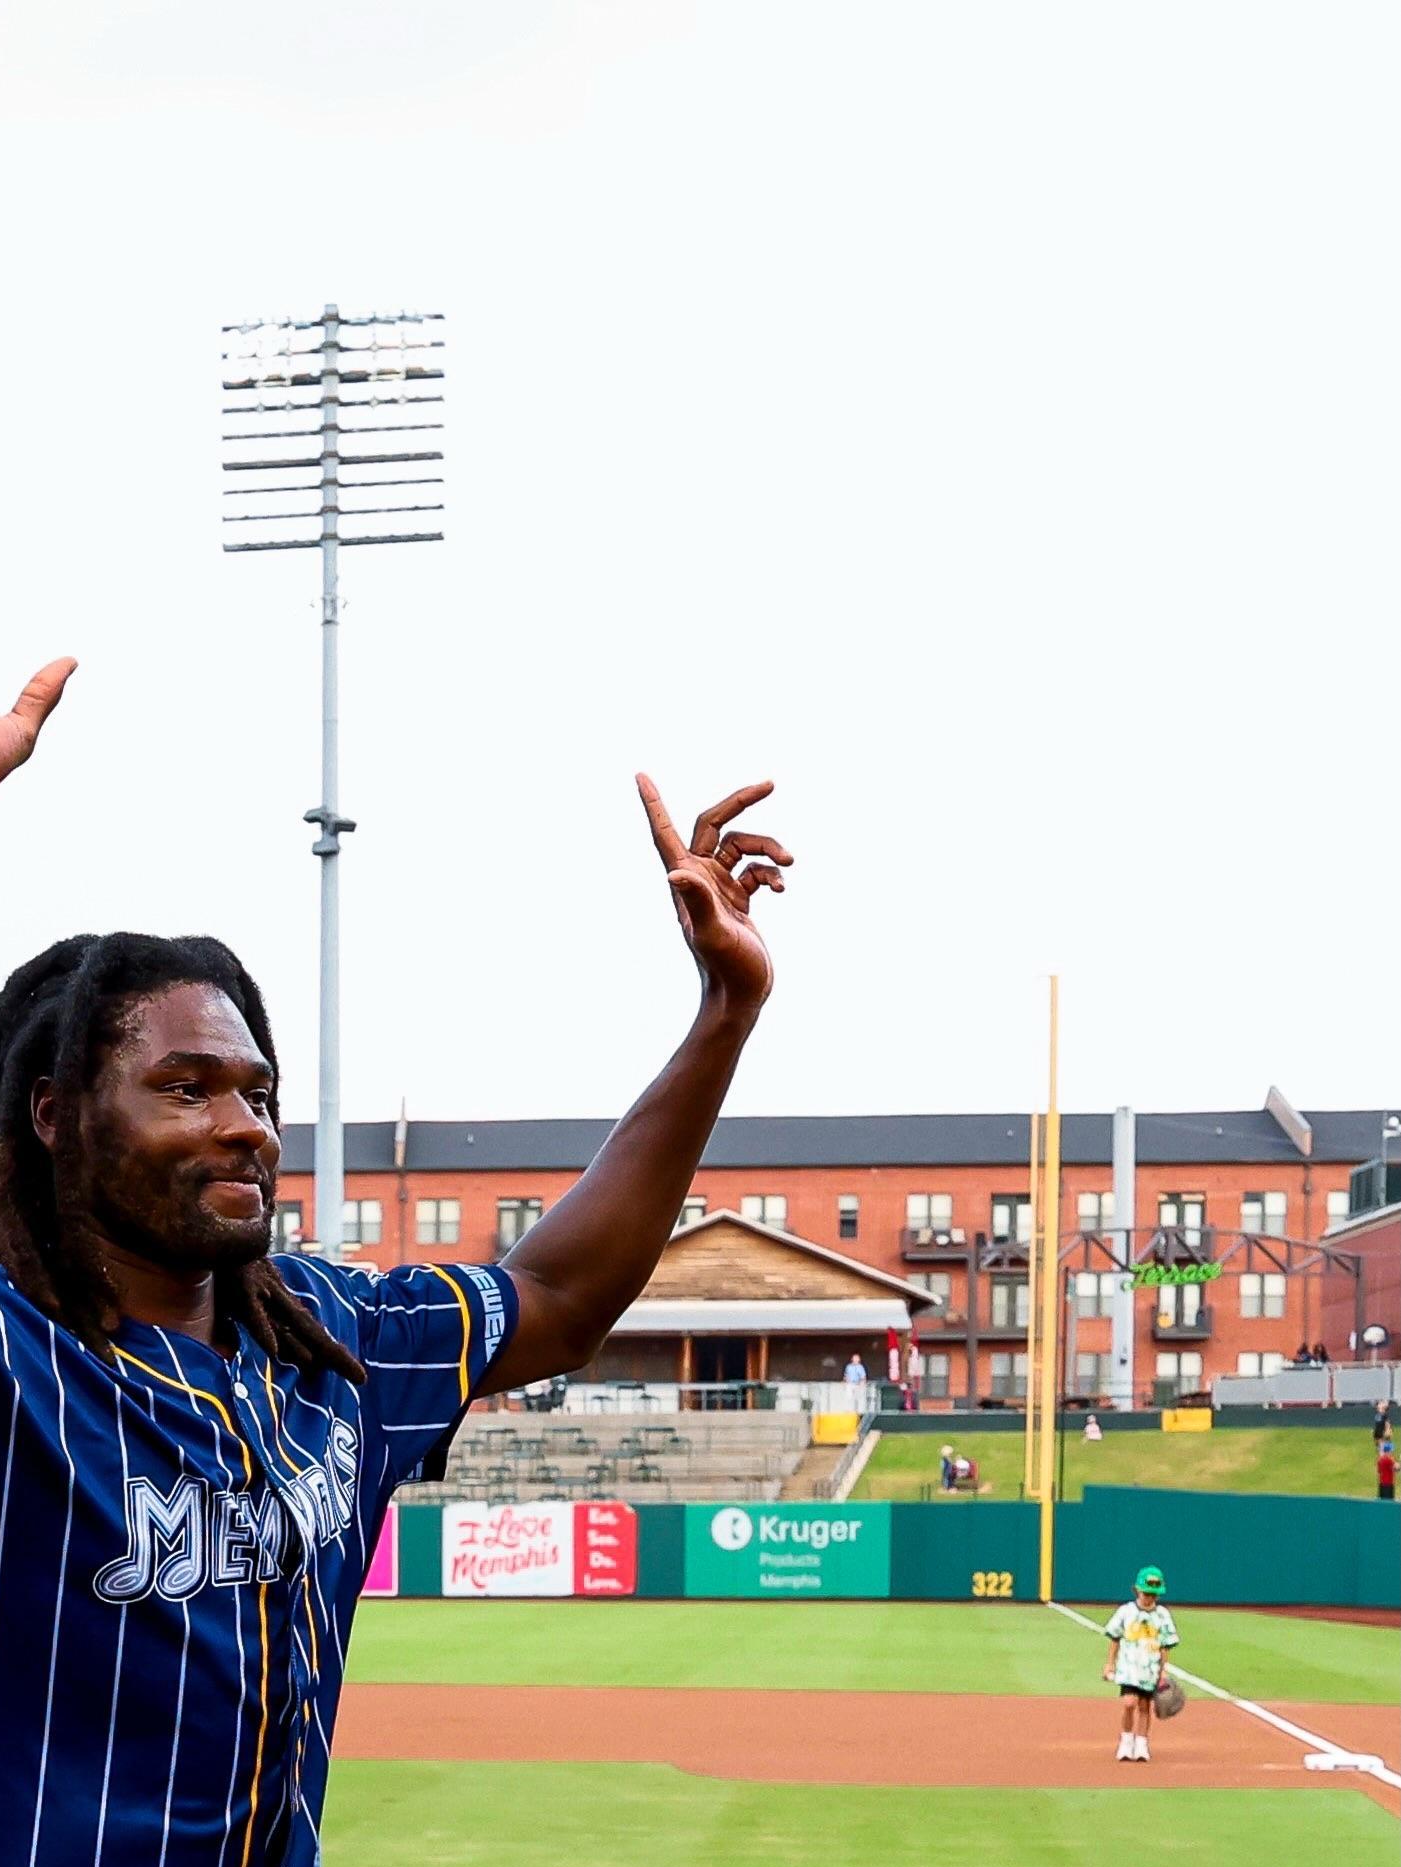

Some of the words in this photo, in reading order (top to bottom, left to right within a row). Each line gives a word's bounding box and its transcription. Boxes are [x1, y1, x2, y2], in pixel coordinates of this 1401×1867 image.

[760, 1515, 863, 1549] Kruger
[452, 1540, 560, 1589] Memphis
[971, 1571, 1013, 1598] 322
